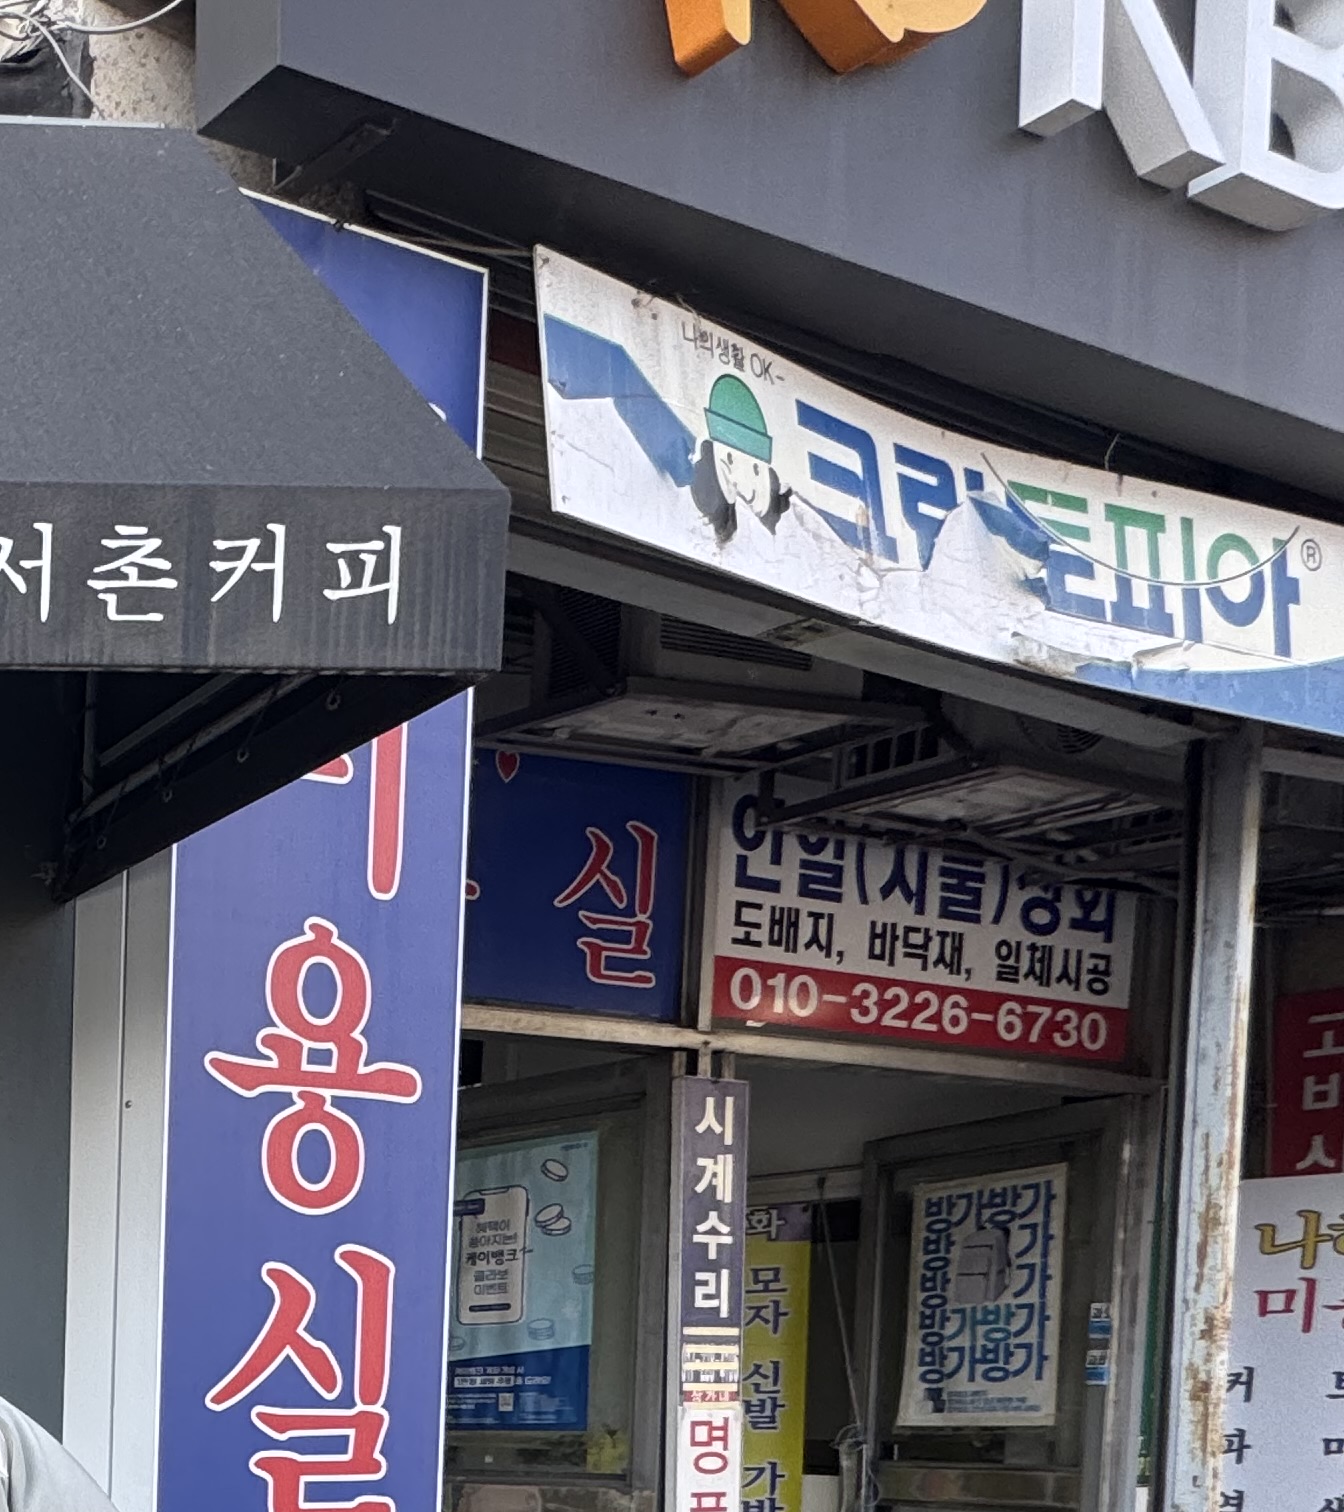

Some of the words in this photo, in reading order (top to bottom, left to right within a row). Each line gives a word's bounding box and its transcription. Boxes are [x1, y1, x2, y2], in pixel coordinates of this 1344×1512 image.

[995, 937, 1113, 996] 일체시공
[729, 967, 1108, 1052] 010-3226-6730
[692, 1096, 735, 1318] 시계수리
[745, 1266, 789, 1335] 모자
[742, 1360, 786, 1431] 신발
